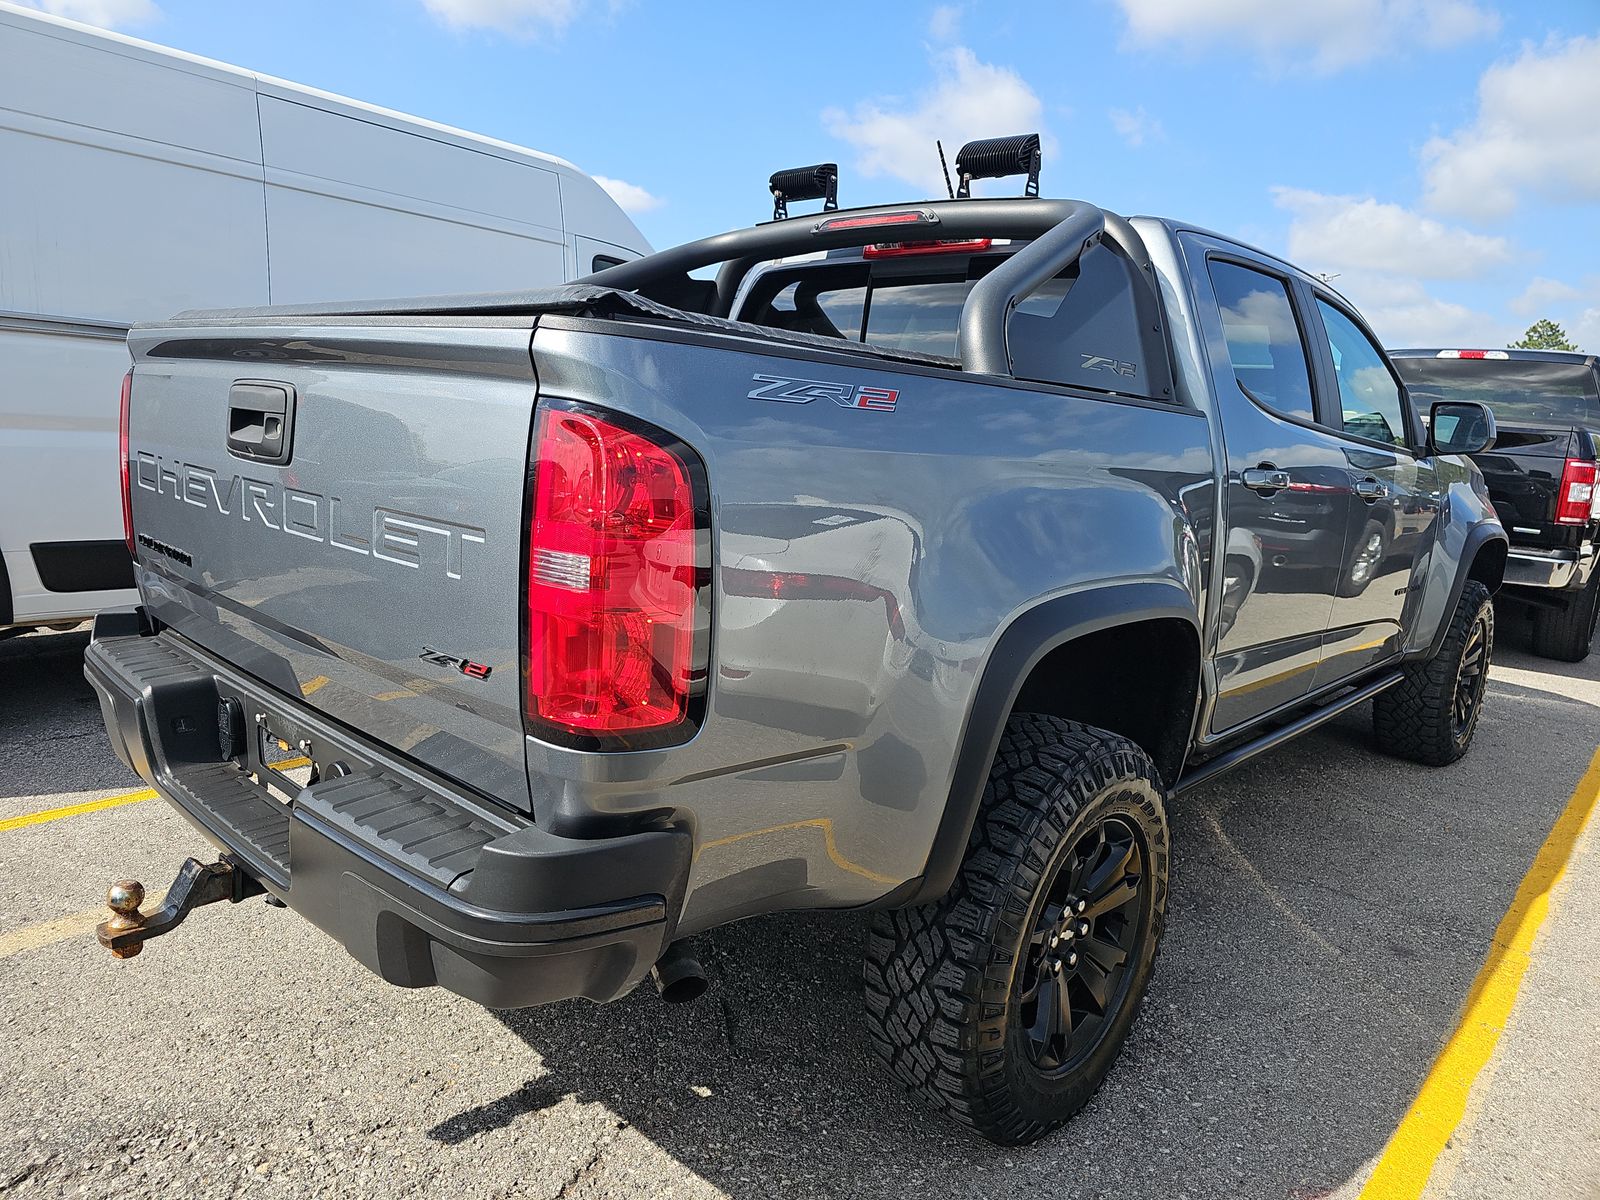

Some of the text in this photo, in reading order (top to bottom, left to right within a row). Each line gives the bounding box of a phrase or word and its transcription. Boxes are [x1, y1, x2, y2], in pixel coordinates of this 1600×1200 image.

[1080, 353, 1136, 378] ZR2
[747, 373, 899, 412] ZR2
[137, 451, 485, 579] CHEVROLET
[419, 646, 492, 682] ZR2
[1100, 789, 1166, 938] GOODYEAR
